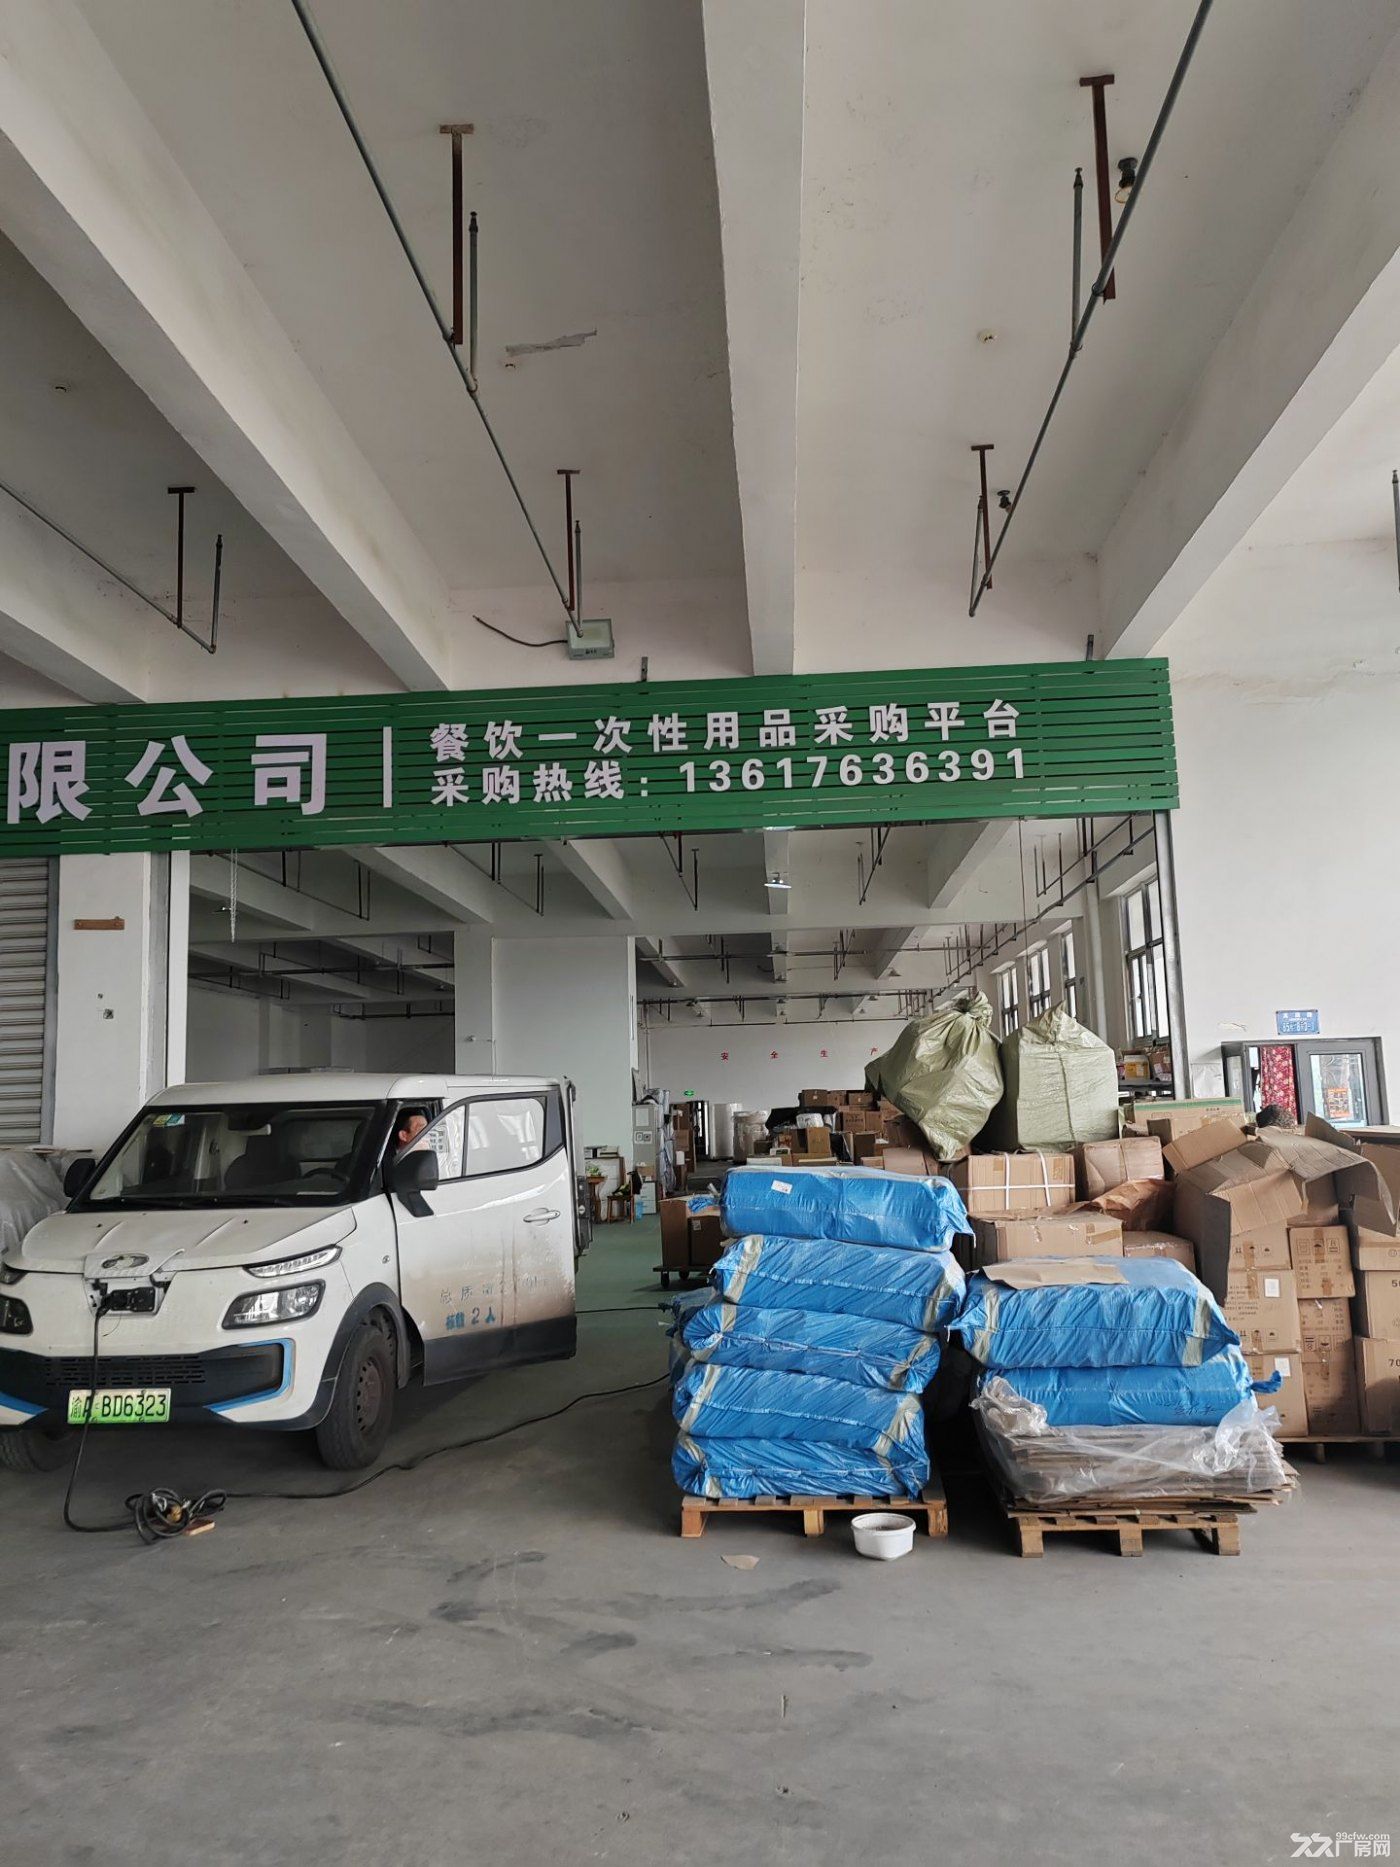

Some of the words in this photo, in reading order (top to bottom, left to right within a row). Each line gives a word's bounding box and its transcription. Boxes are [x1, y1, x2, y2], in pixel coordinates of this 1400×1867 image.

[430, 698, 1020, 762] 餐饮一次性用品采购平台
[7, 733, 327, 824] 限公司
